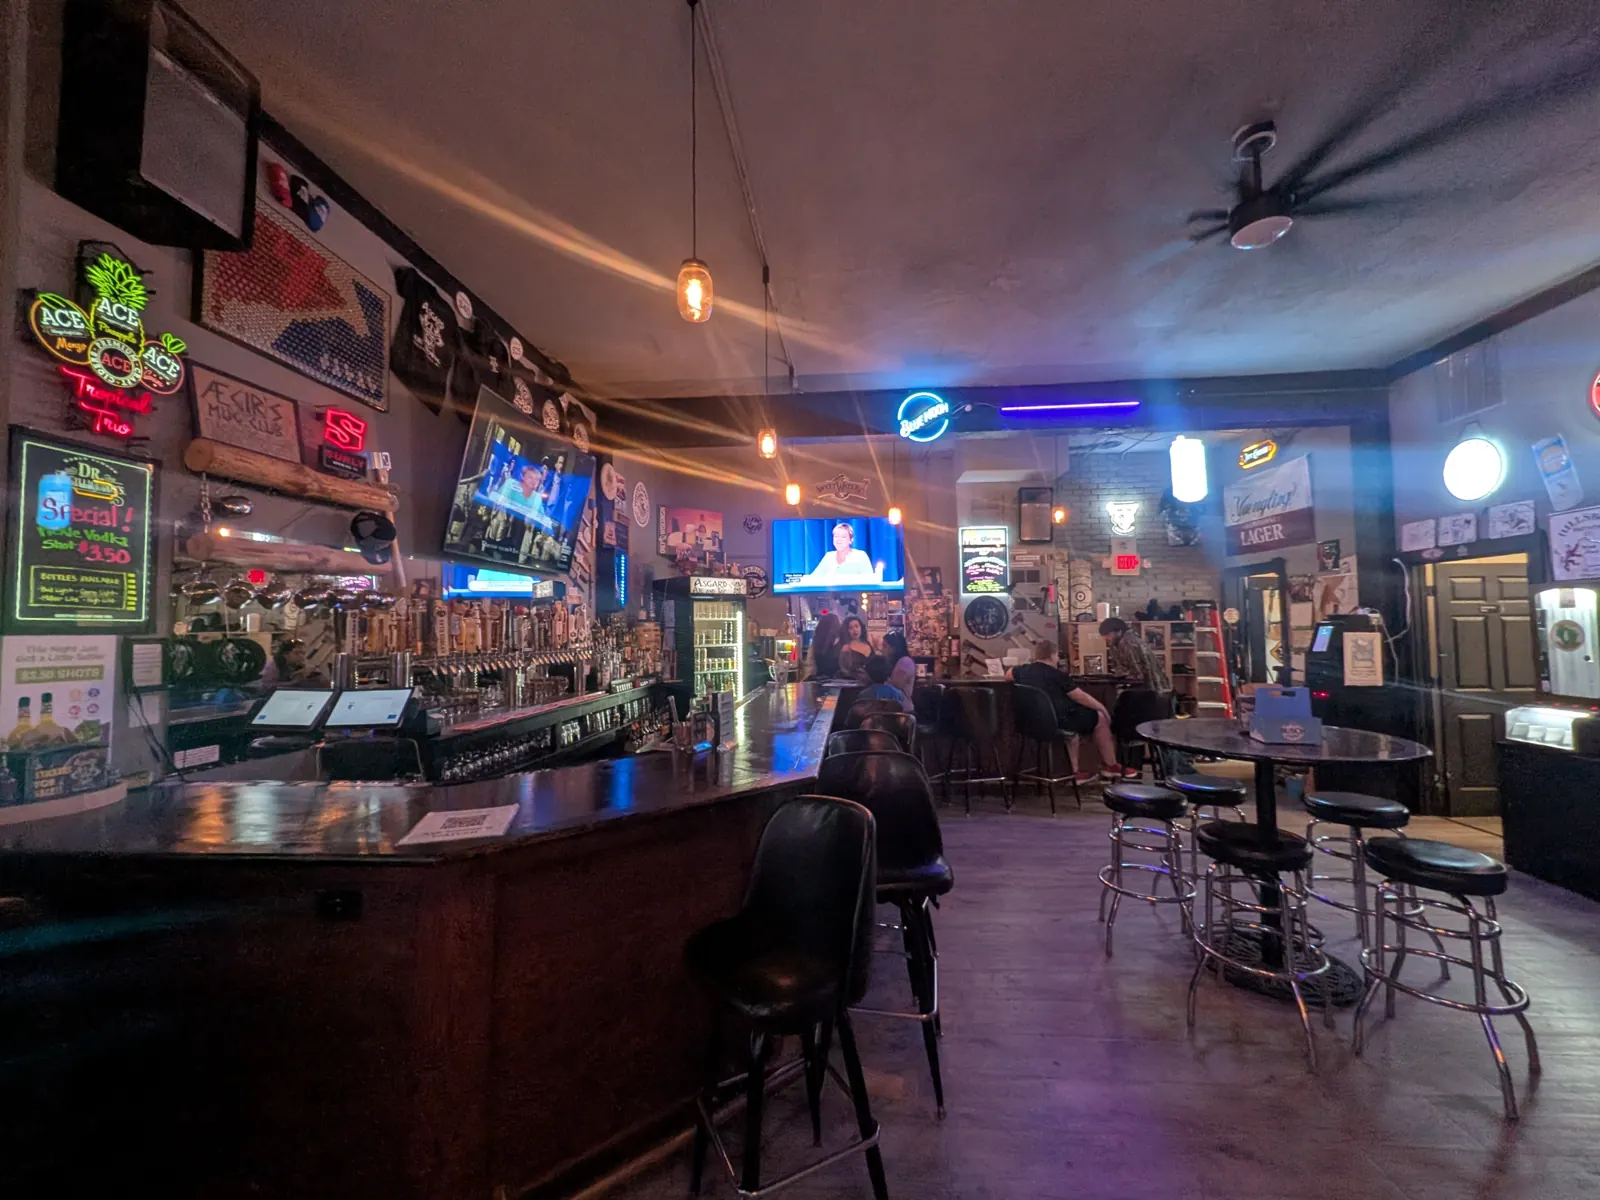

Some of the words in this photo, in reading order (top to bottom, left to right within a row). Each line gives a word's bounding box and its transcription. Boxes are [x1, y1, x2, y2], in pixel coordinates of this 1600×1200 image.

[40, 306, 85, 329] ACE
[98, 297, 139, 327] ACE
[101, 352, 131, 373] ACE
[142, 346, 180, 378] ACE
[62, 366, 152, 414] Tropical
[327, 450, 364, 470] SURLY
[1240, 524, 1285, 546] LAGER
[694, 578, 728, 589] ASGARD
[57, 667, 100, 680] SHOTS
